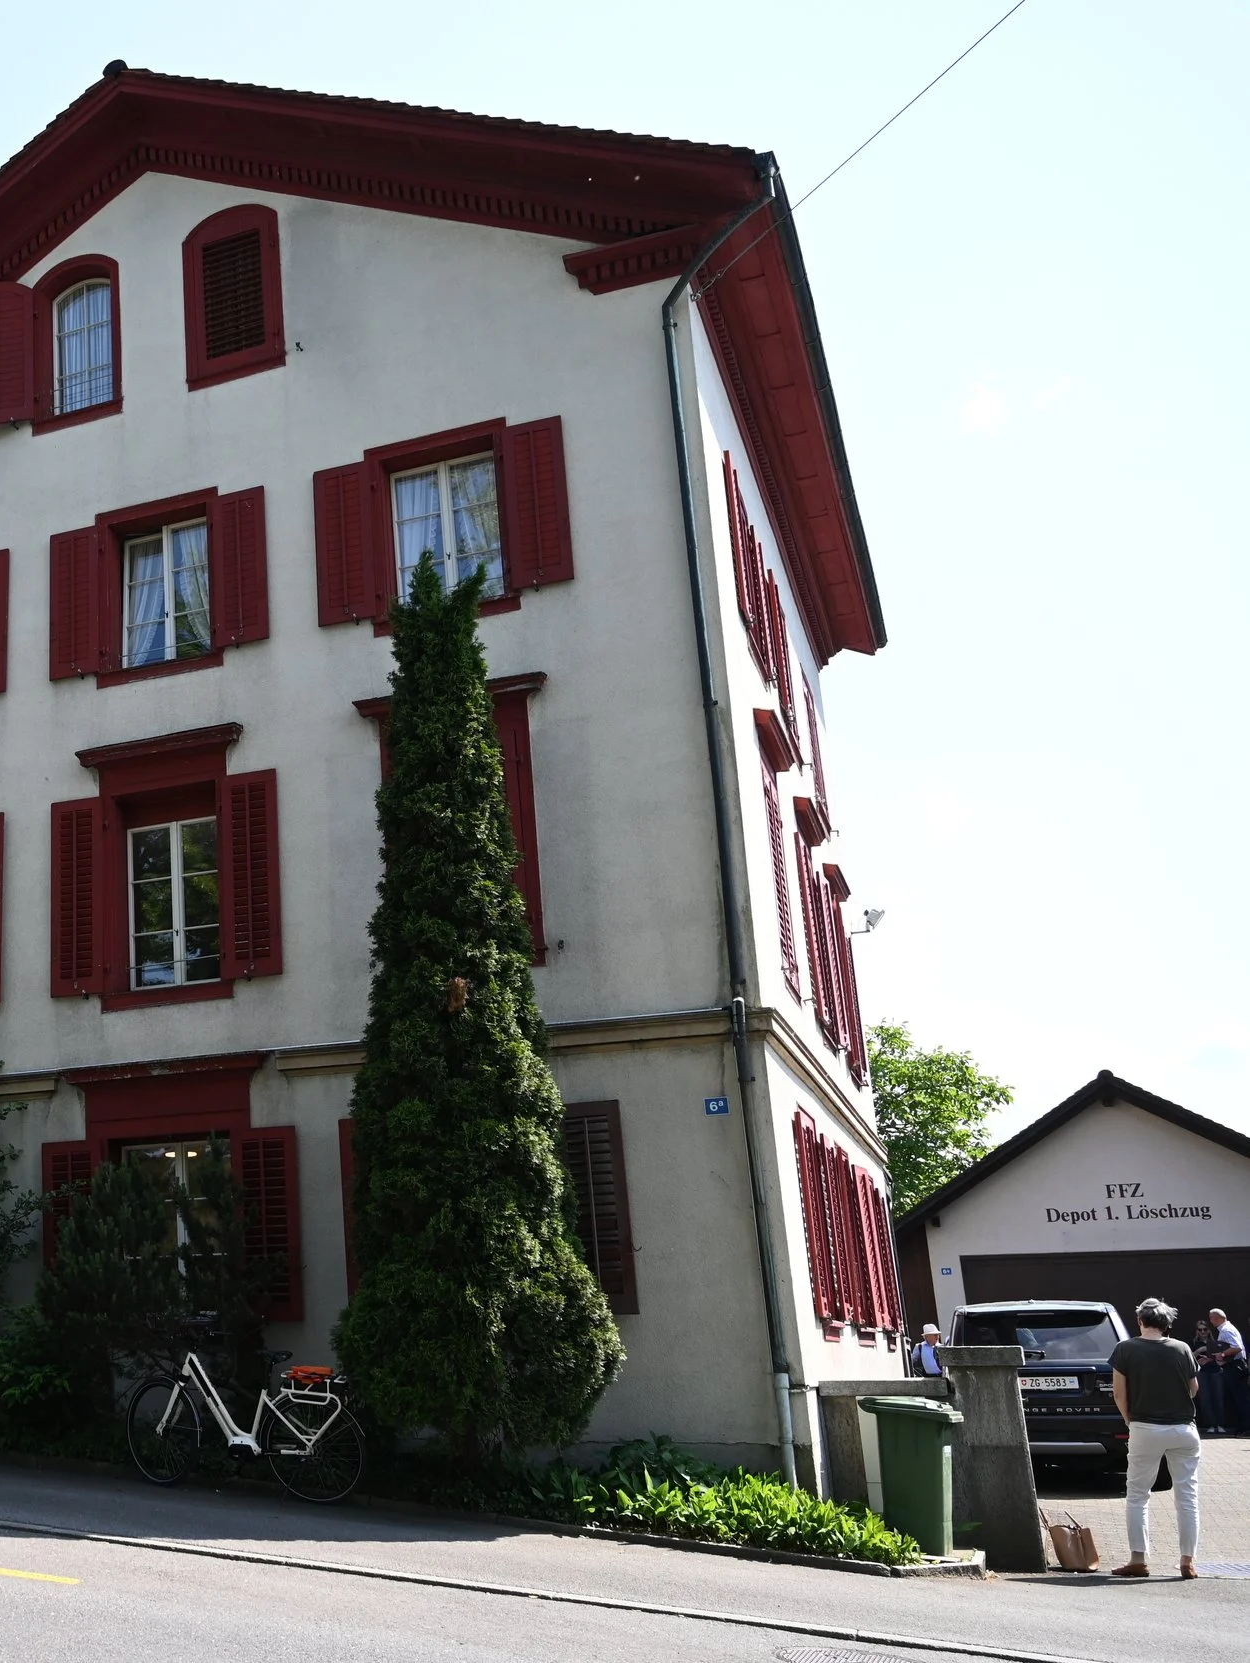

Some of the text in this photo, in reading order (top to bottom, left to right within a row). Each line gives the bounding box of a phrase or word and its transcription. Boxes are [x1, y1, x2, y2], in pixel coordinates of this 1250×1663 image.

[709, 1100, 724, 1112] 6a
[1105, 1182, 1144, 1199] FFZ
[1045, 1203, 1212, 1225] Depot 1. Löschzug
